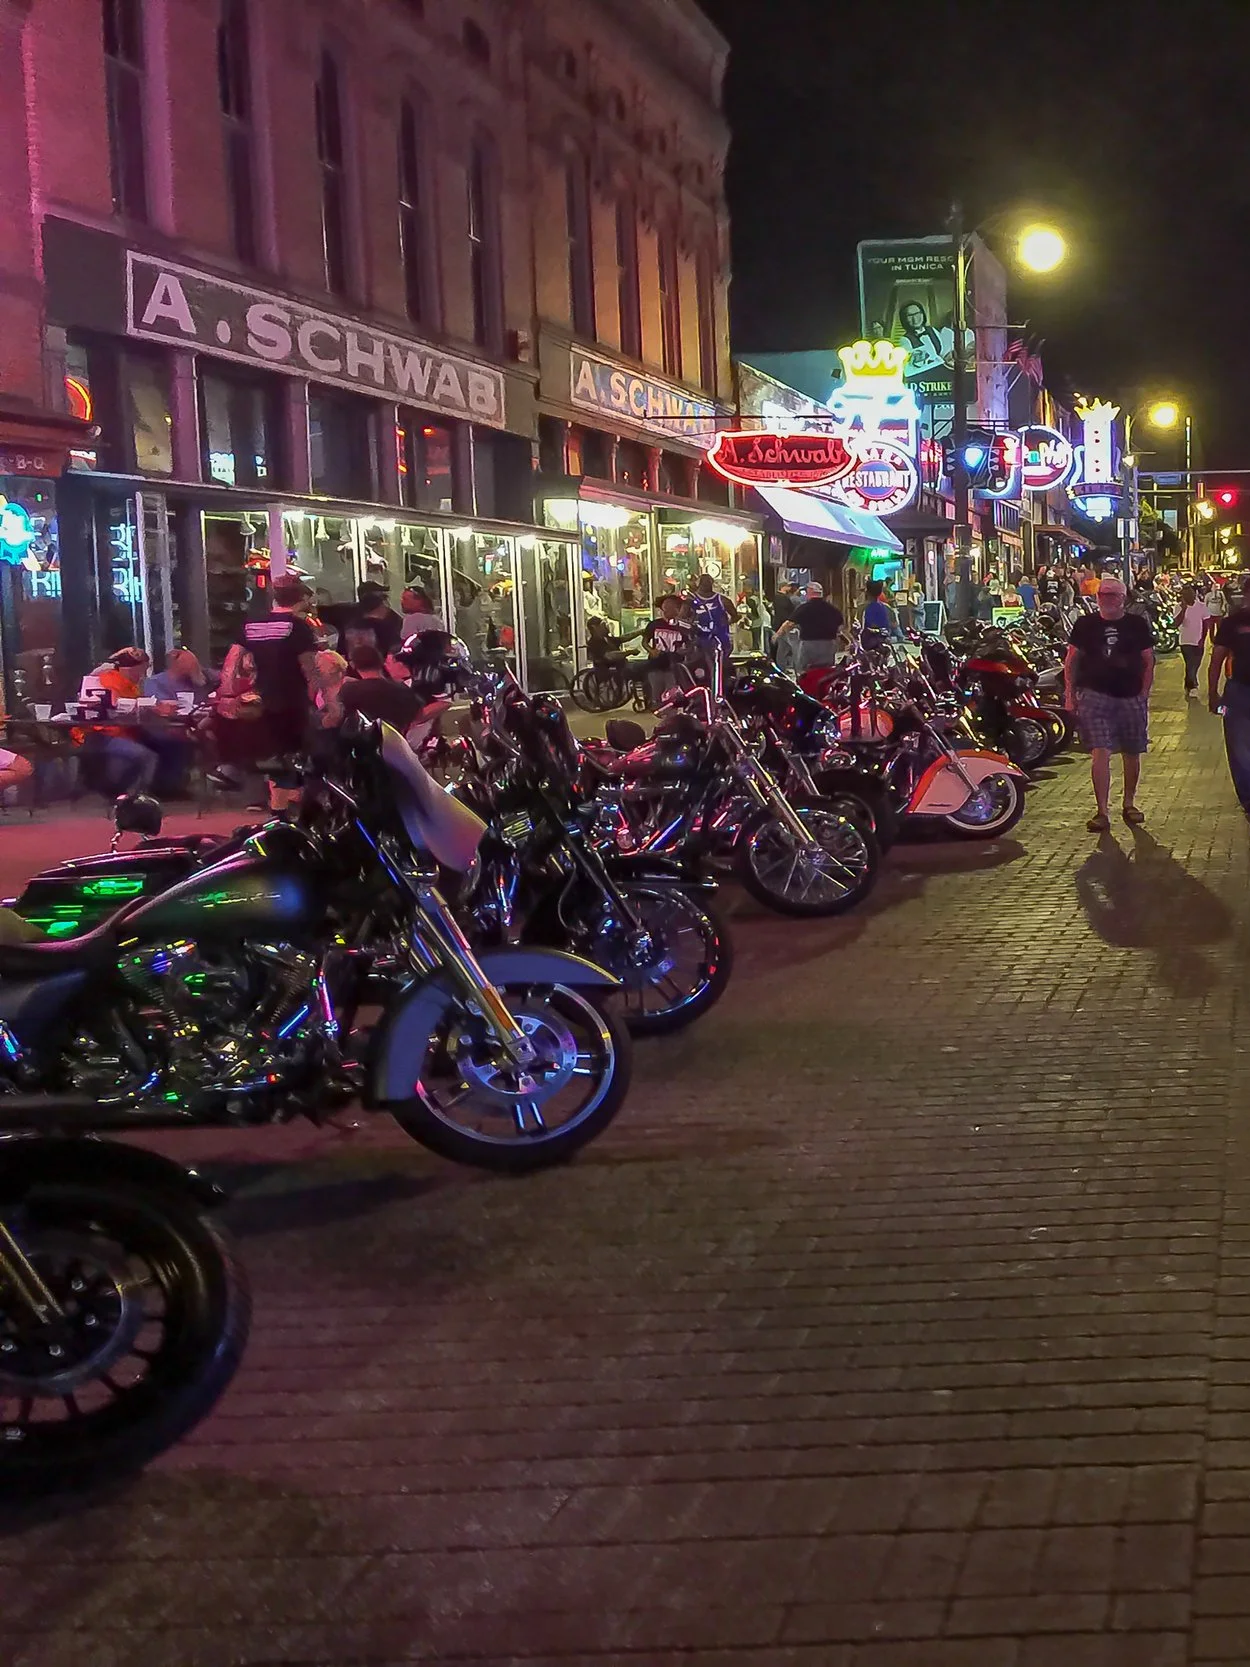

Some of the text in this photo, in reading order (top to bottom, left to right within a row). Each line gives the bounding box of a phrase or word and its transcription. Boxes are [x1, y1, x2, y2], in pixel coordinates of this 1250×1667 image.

[246, 303, 497, 416] SCHWAB
[919, 381, 952, 392] STRIKE
[750, 438, 842, 463] Schwab
